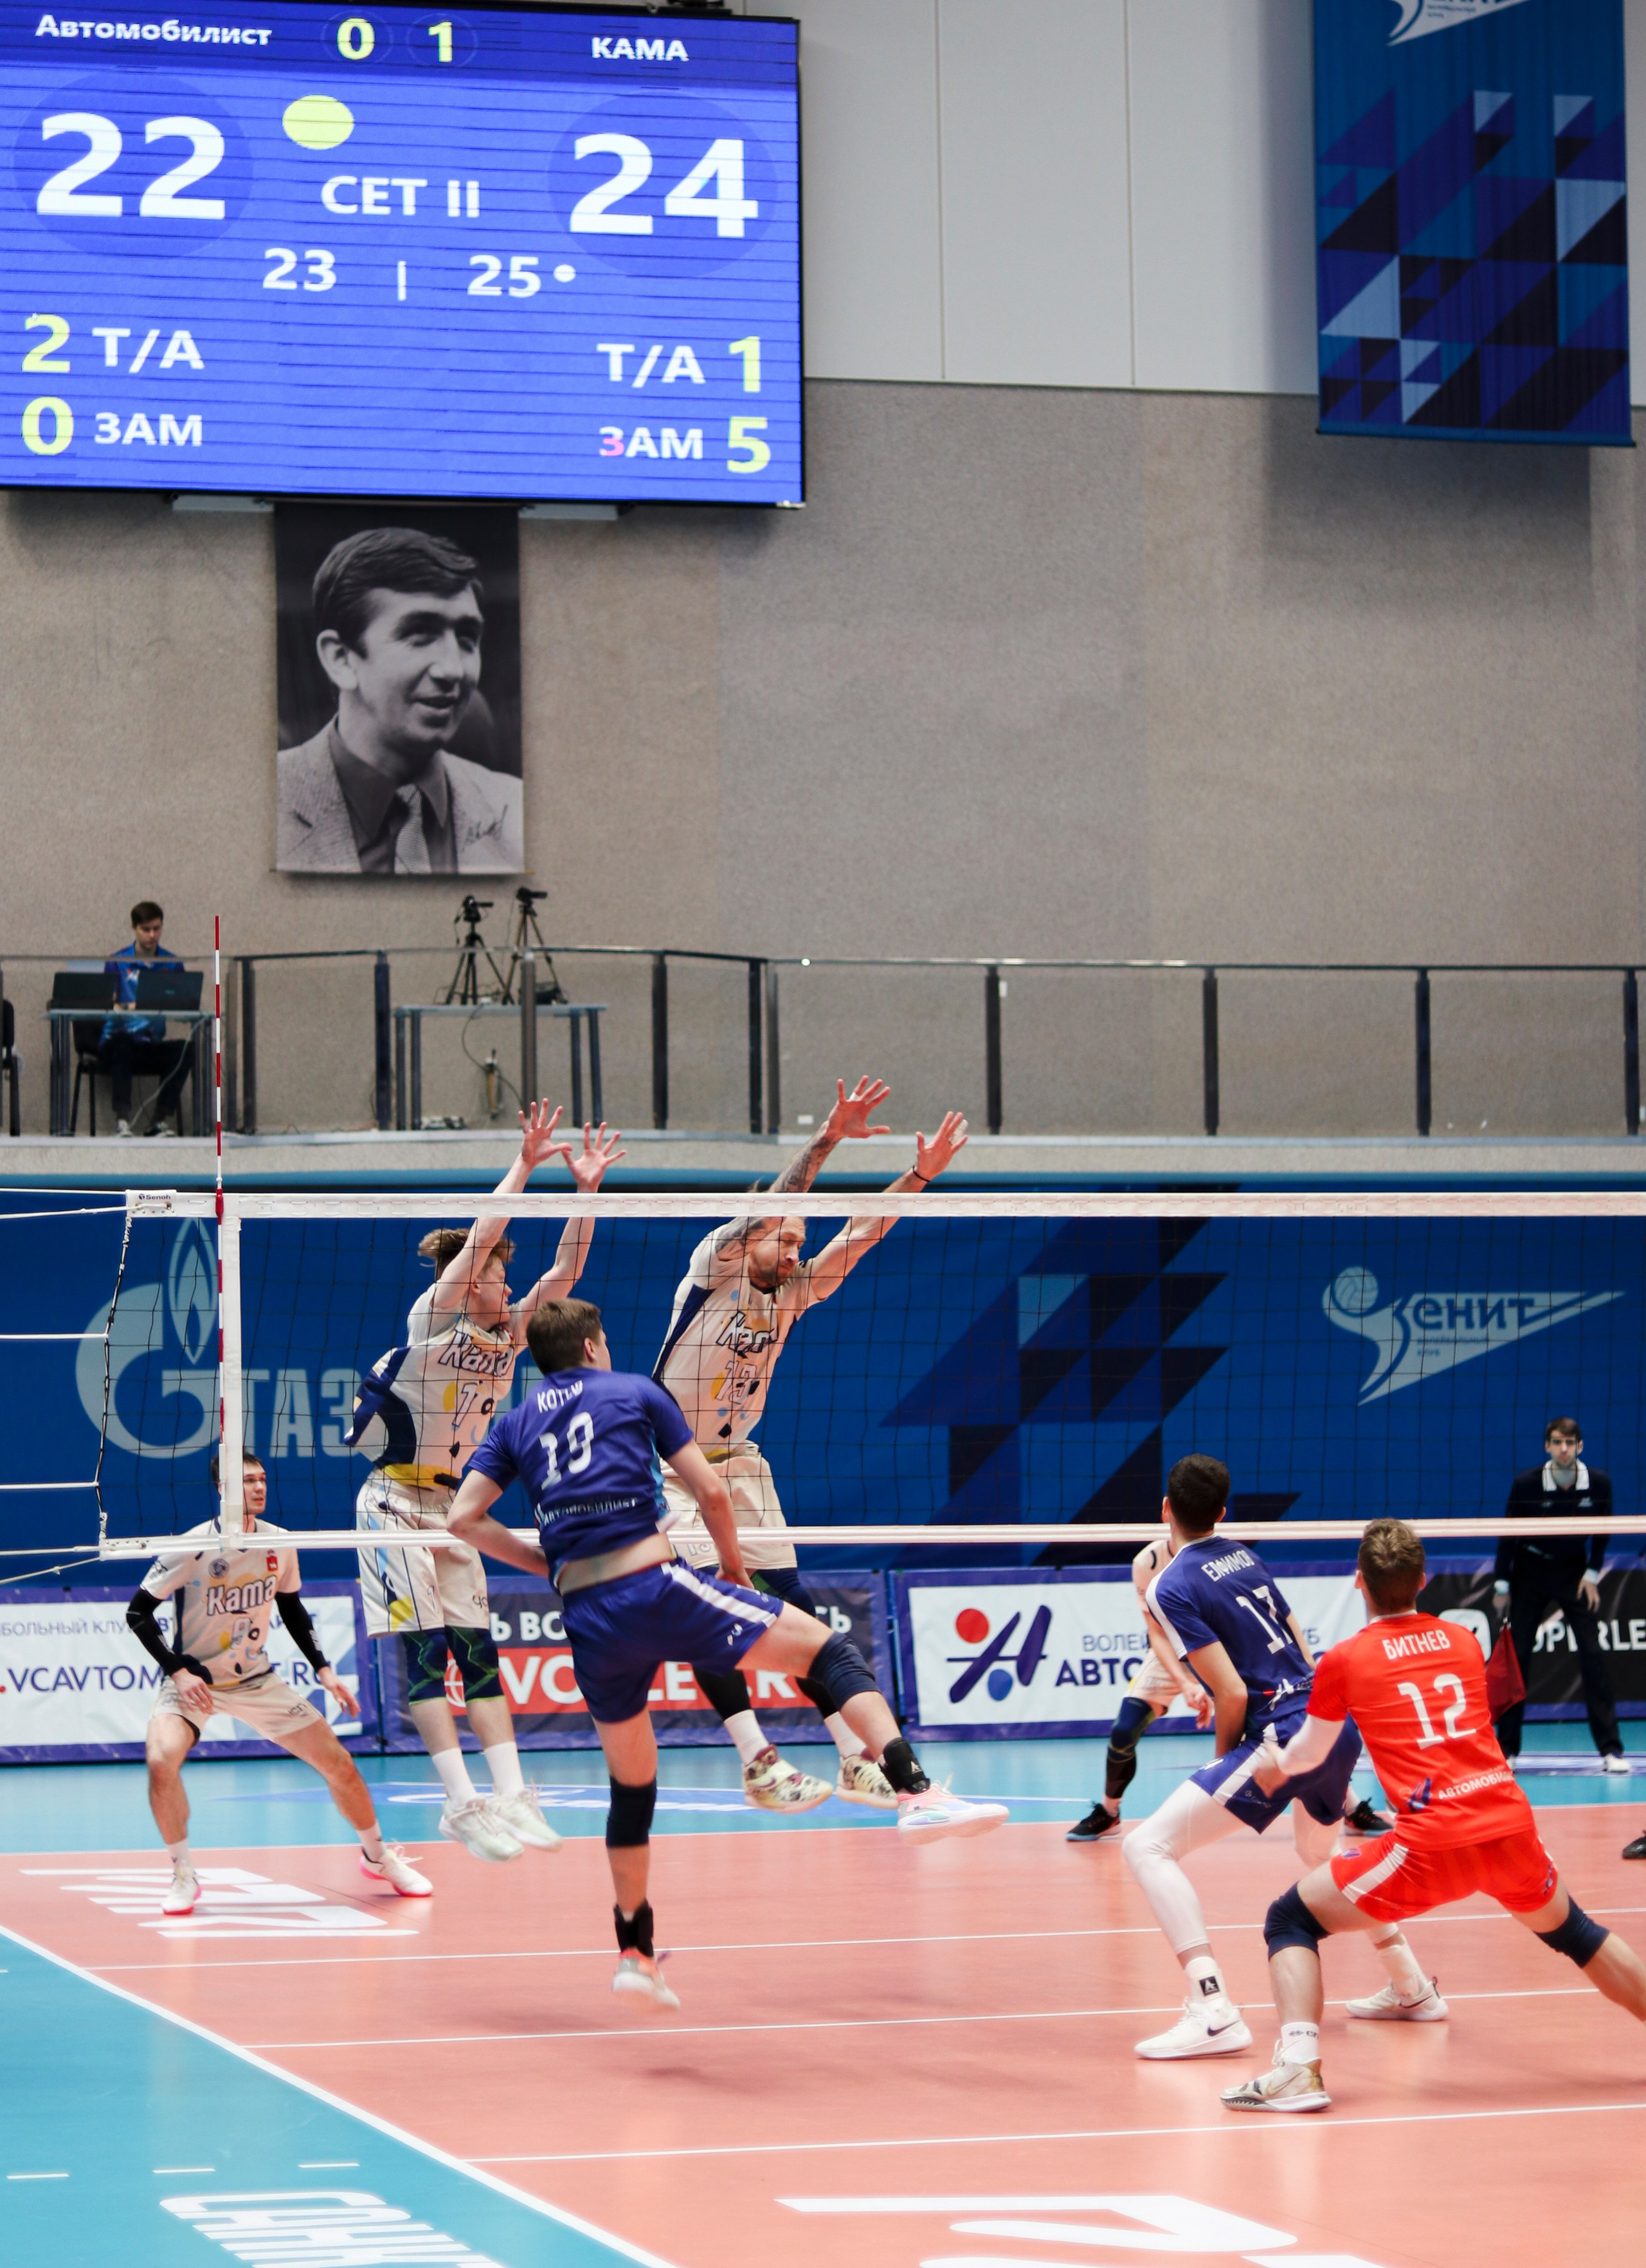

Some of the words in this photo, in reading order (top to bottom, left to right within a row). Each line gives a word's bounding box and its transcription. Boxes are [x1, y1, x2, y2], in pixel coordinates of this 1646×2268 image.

[36, 15, 272, 45] Автомобилист
[337, 18, 375, 60] 0
[429, 22, 453, 62] 1
[591, 37, 689, 62] КАМА
[37, 113, 225, 219] 22
[570, 133, 758, 237] 24
[321, 176, 428, 215] СЕТ
[263, 248, 336, 291] 23
[467, 255, 541, 298] 25
[22, 313, 71, 373] 2
[92, 327, 204, 374] Т/А
[597, 343, 706, 388] Т/А
[729, 336, 761, 392] 1
[22, 396, 74, 455] 0
[95, 412, 203, 446] ЗАМ
[599, 426, 703, 459] ЗАМ
[727, 416, 771, 474] 5
[539, 1411, 594, 1491] 19
[92, 1619, 133, 1635] КЛУ
[1235, 1585, 1294, 1654] 17
[1382, 1629, 1451, 1661] БИТНЕВ
[1397, 1673, 1477, 1751] 12
